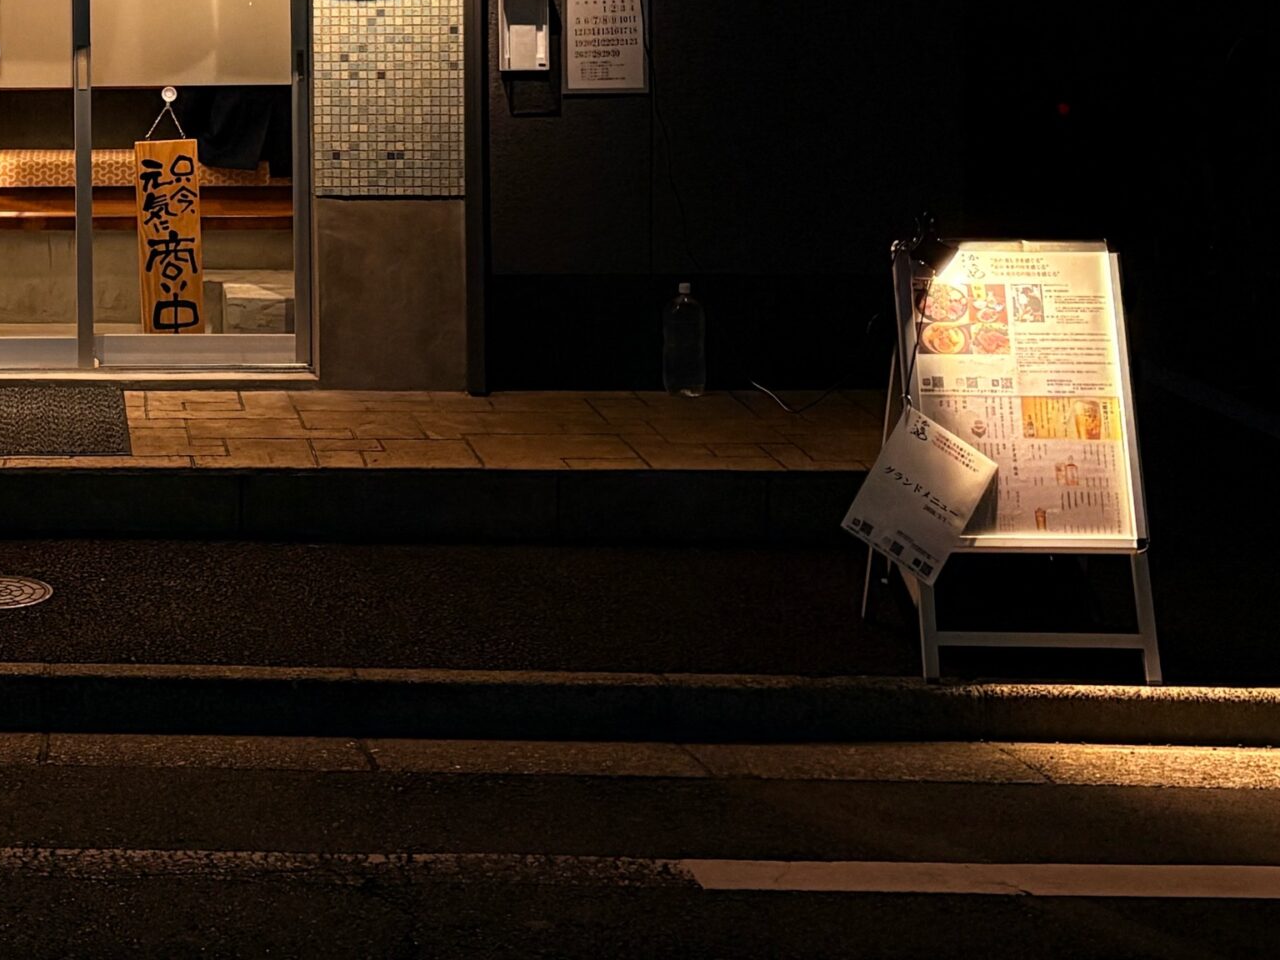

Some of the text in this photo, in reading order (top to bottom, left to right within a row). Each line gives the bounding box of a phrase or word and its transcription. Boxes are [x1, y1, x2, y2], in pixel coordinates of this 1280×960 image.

[140, 159, 178, 233] 元気に
[170, 155, 198, 214] 只今
[146, 230, 200, 334] 商い中
